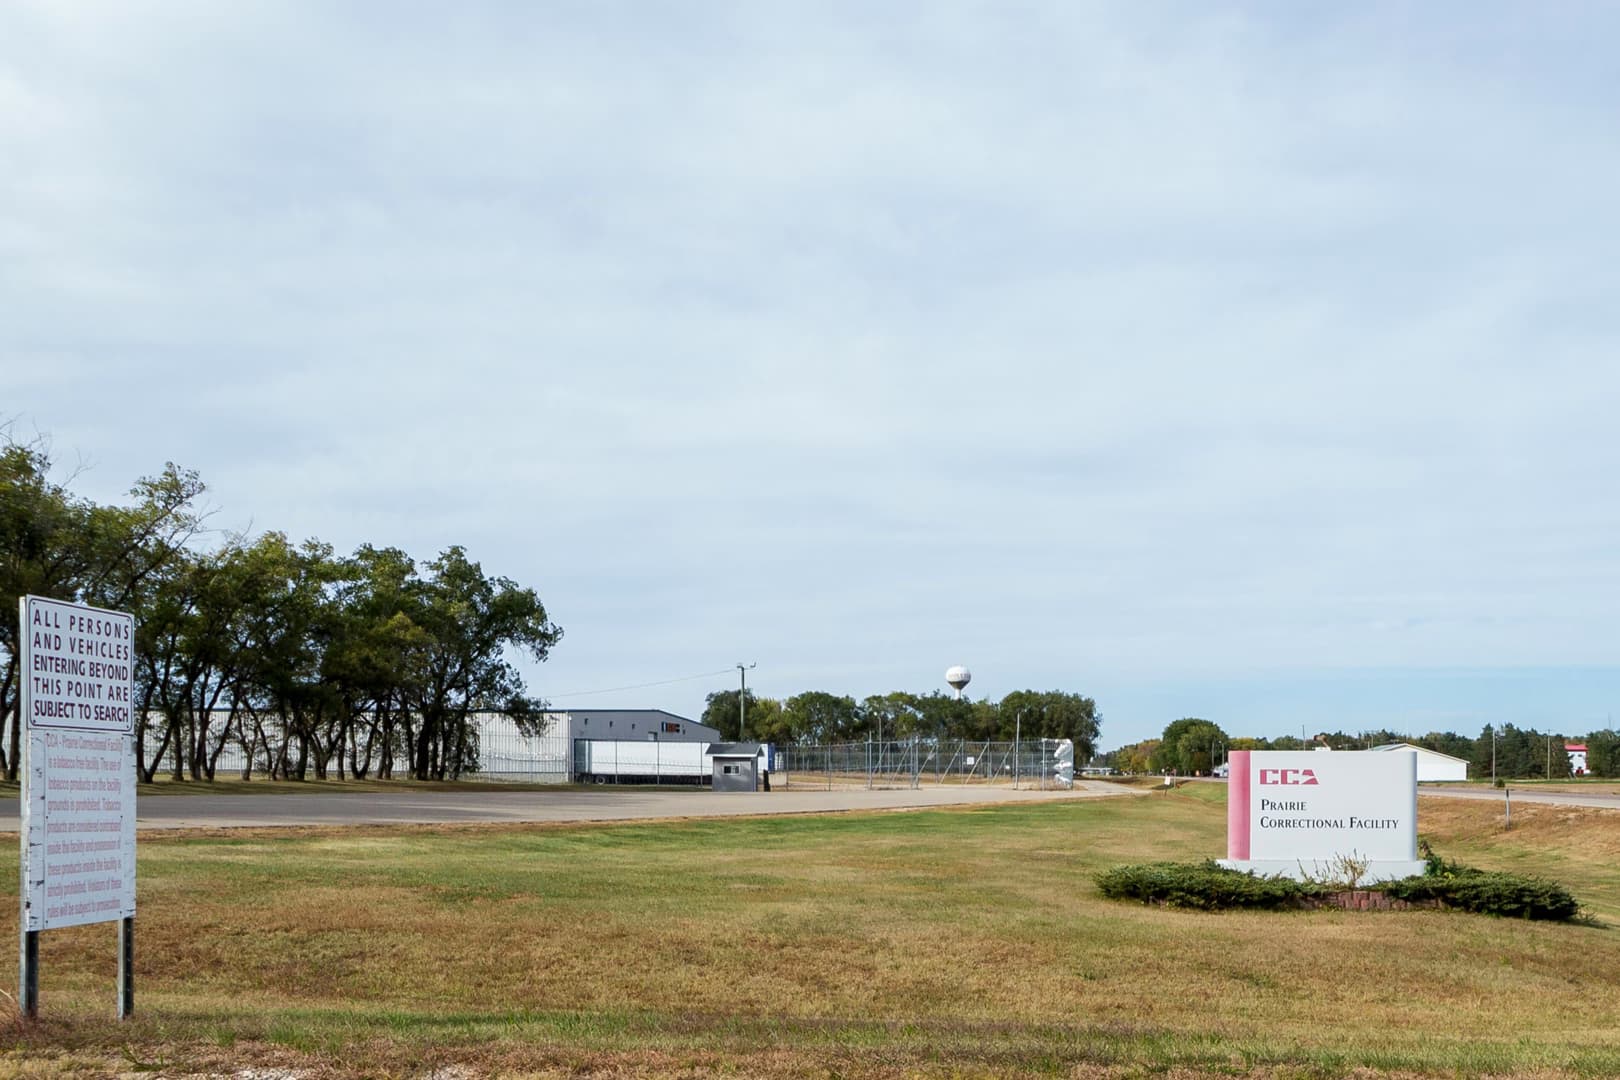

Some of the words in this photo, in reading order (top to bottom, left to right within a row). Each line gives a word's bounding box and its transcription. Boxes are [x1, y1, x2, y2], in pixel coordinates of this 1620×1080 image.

[33, 608, 60, 629] ALL
[69, 615, 129, 640] PERSONS
[33, 632, 61, 651] AND
[69, 636, 129, 660] VEHICLES
[34, 654, 85, 676] ENTERING
[89, 661, 128, 681] BEYOND
[33, 677, 61, 695] THIS
[67, 681, 102, 699] POINT
[108, 685, 129, 702] ARE
[34, 700, 75, 719] SUBJECT
[78, 703, 91, 720] TO
[94, 705, 129, 722] SEARCH
[1259, 769, 1320, 785] CCA
[1261, 799, 1307, 811] PRAIRIE
[1260, 816, 1346, 829] CORRECTIONAL
[1349, 816, 1399, 829] FACILITY
